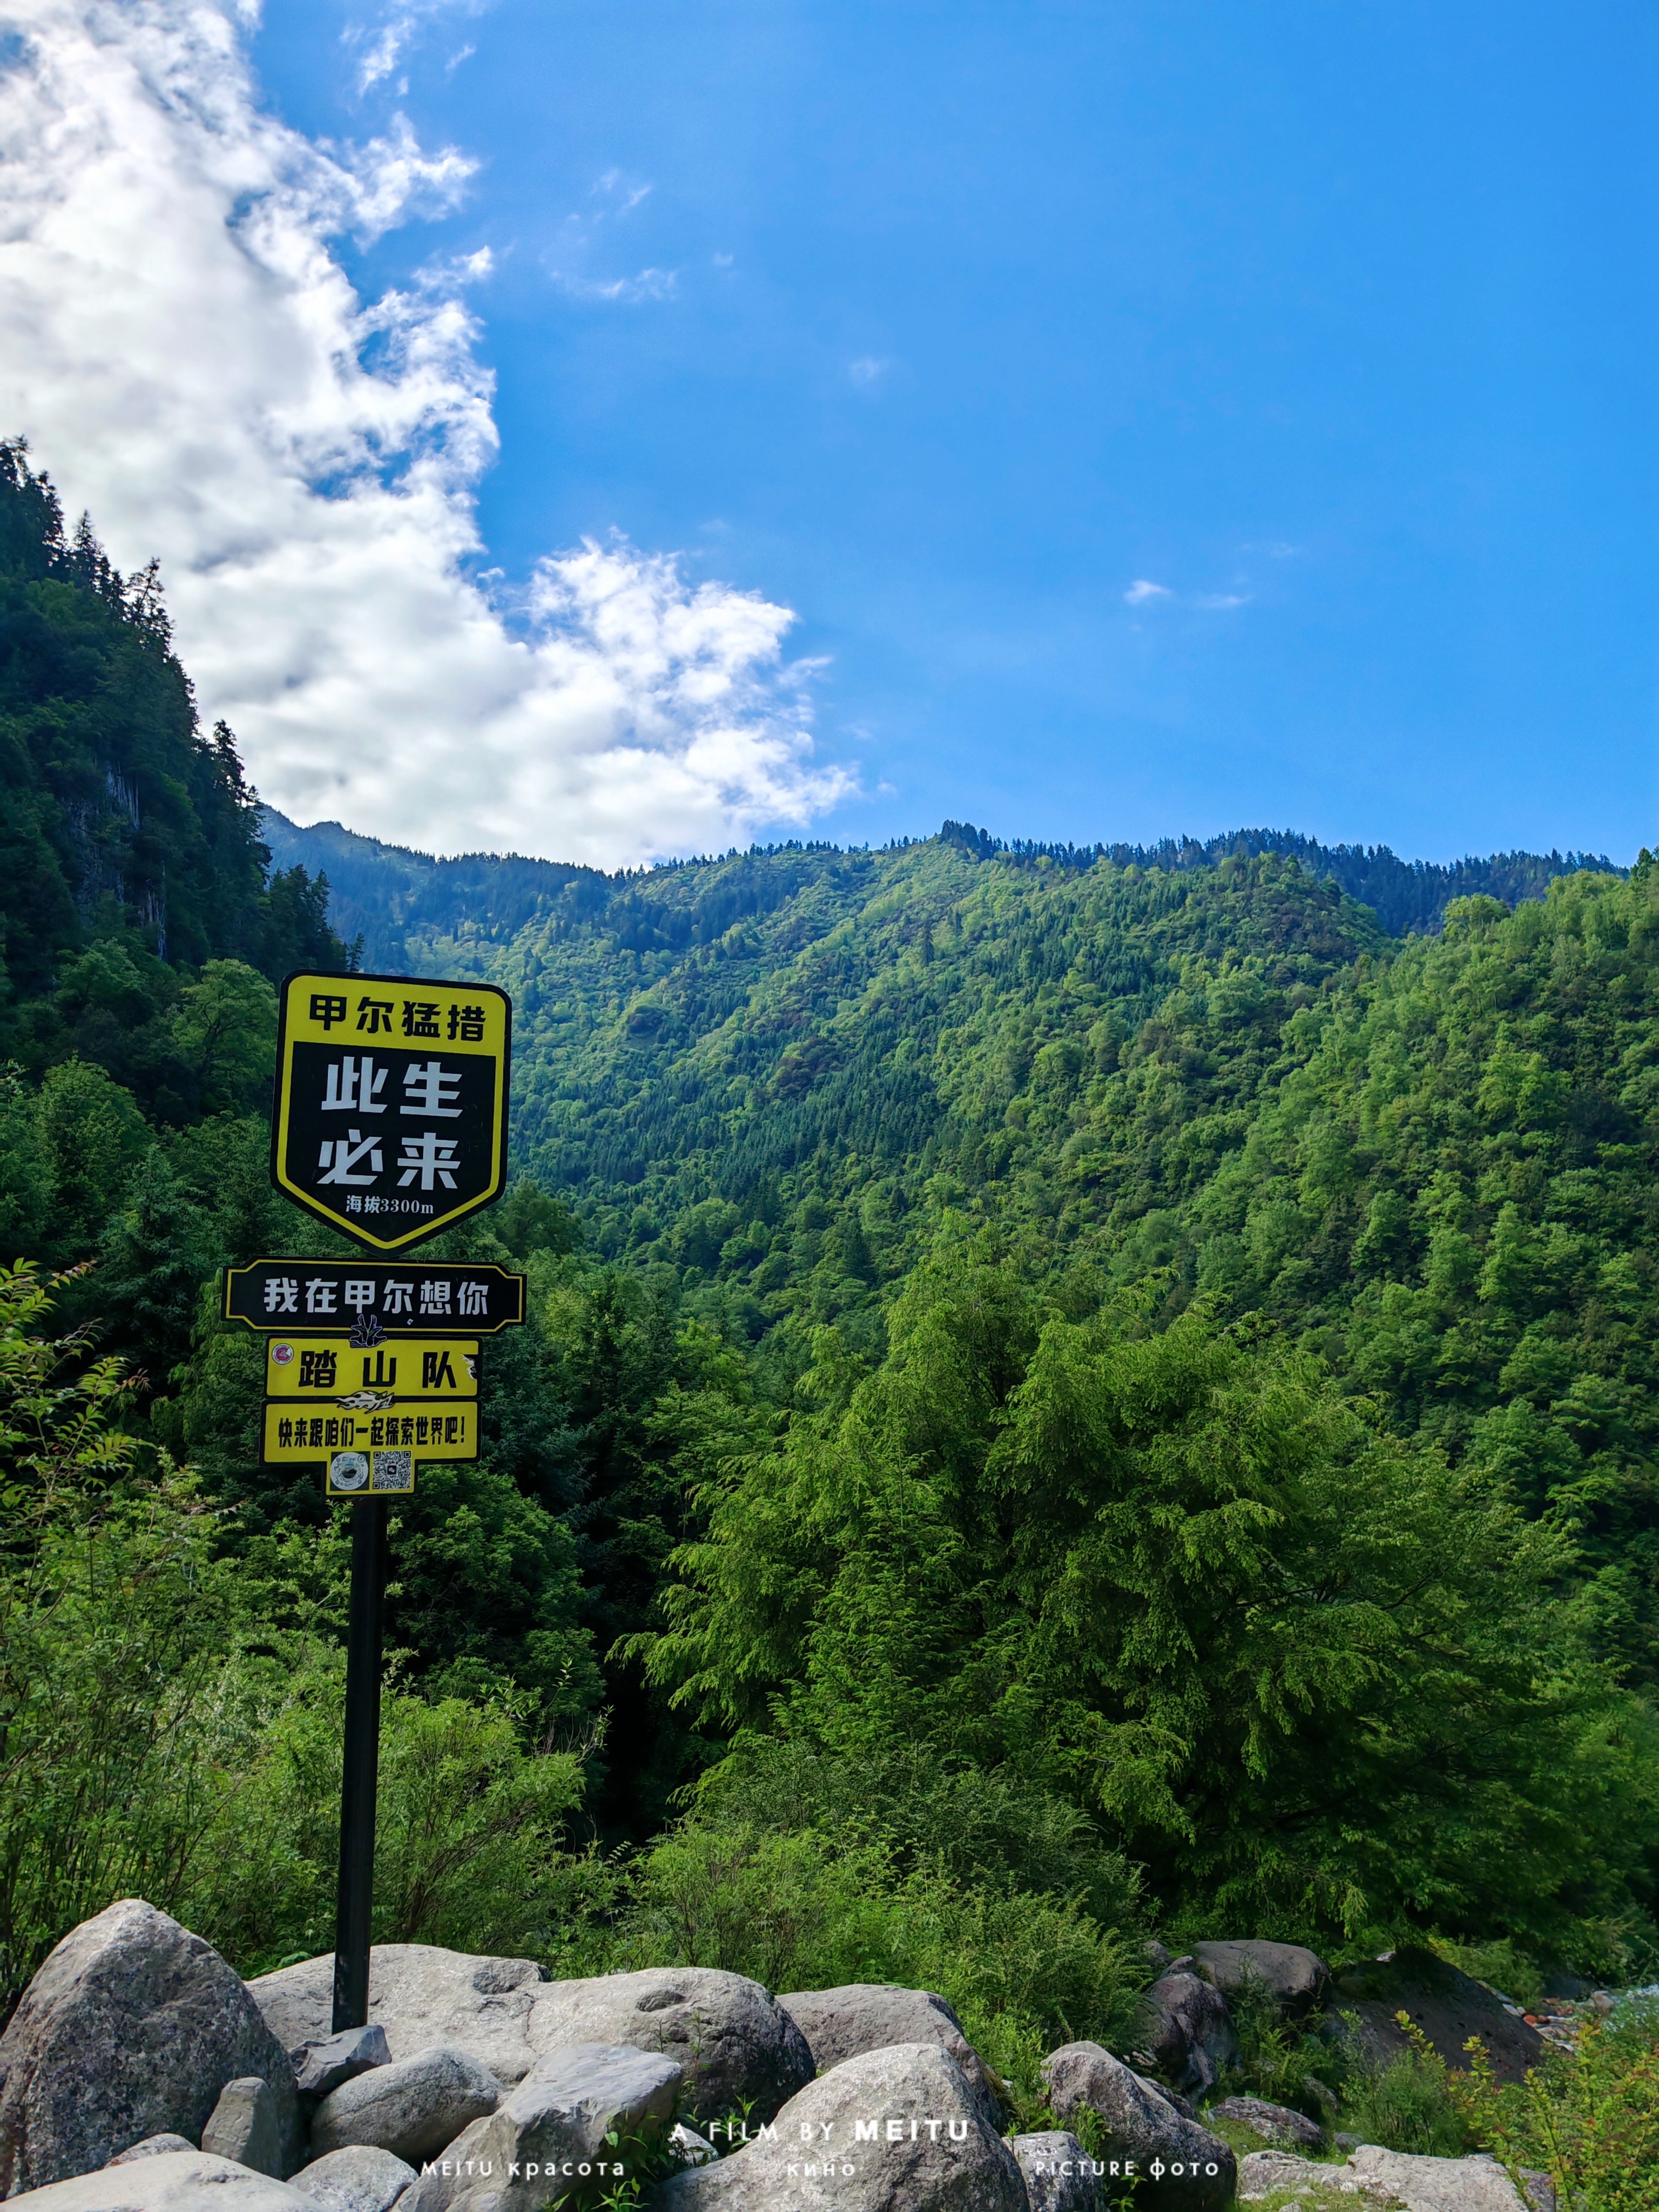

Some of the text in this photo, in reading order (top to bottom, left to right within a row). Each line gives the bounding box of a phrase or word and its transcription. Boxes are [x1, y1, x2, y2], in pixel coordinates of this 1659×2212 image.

[309, 994, 487, 1041] 甲尔猛措
[321, 1056, 463, 1117] 此生
[317, 1129, 461, 1190] 必来
[346, 1195, 434, 1215] 海拔3300m
[264, 1278, 489, 1315] 我在甲尔想你
[299, 1350, 456, 1388] 踏山队
